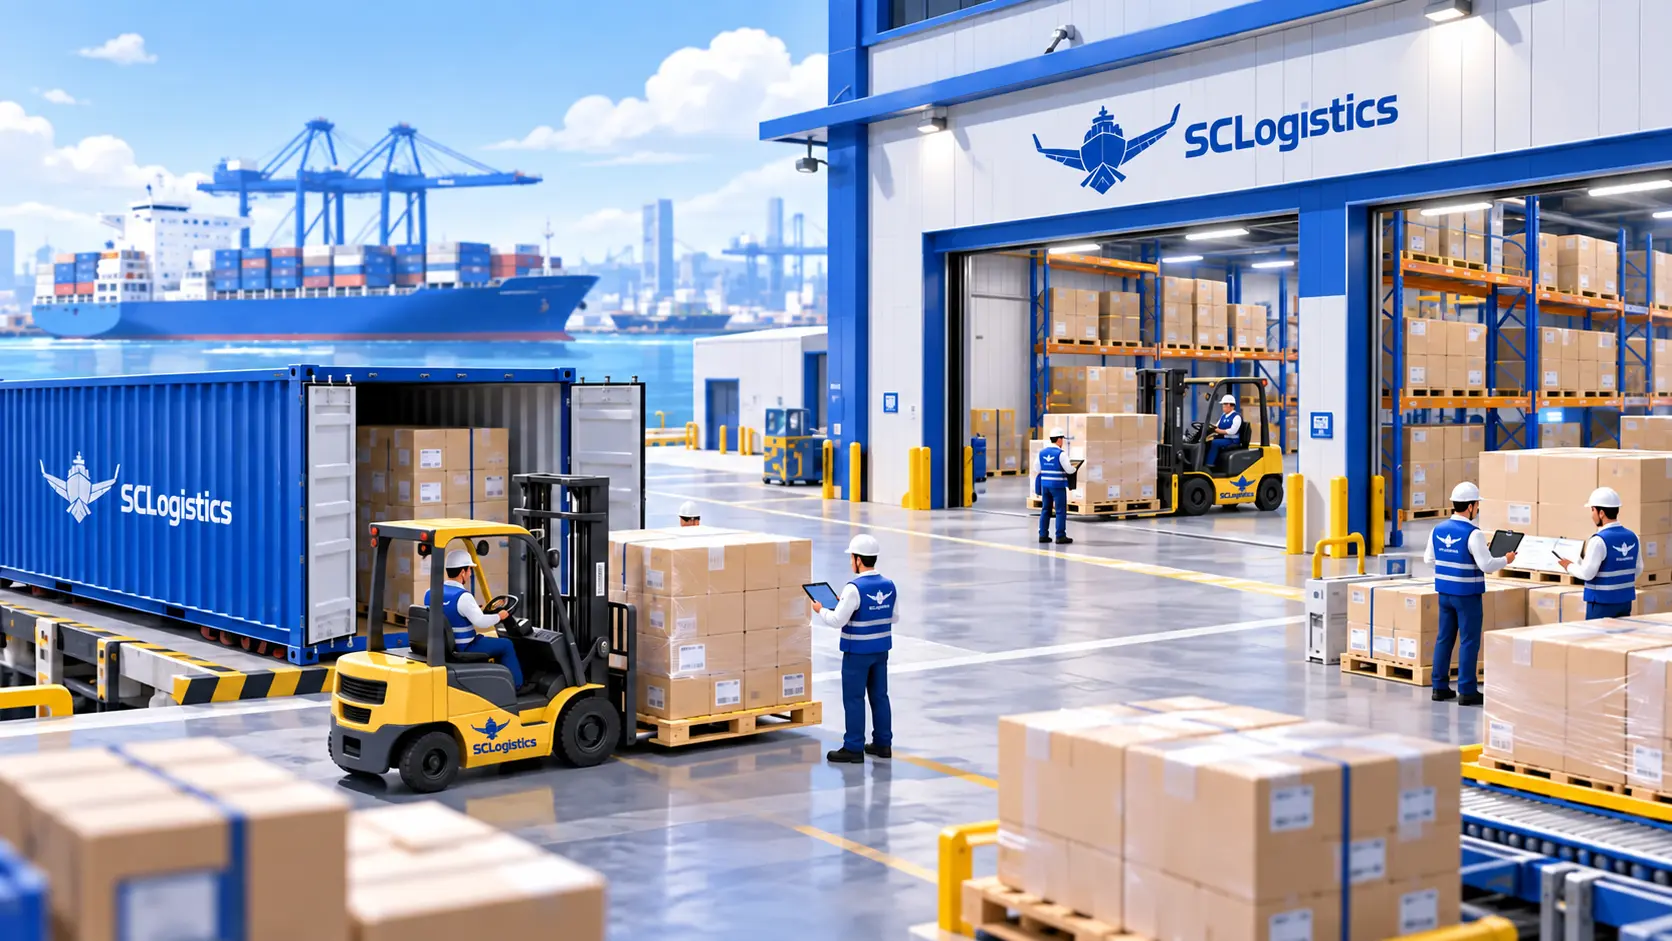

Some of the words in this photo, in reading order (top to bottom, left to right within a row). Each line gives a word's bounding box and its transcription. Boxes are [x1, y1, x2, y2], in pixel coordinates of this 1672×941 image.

[1185, 93, 1399, 158] SCLogistics
[121, 483, 232, 526] SCLogistics
[472, 738, 537, 755] SCLogistics
